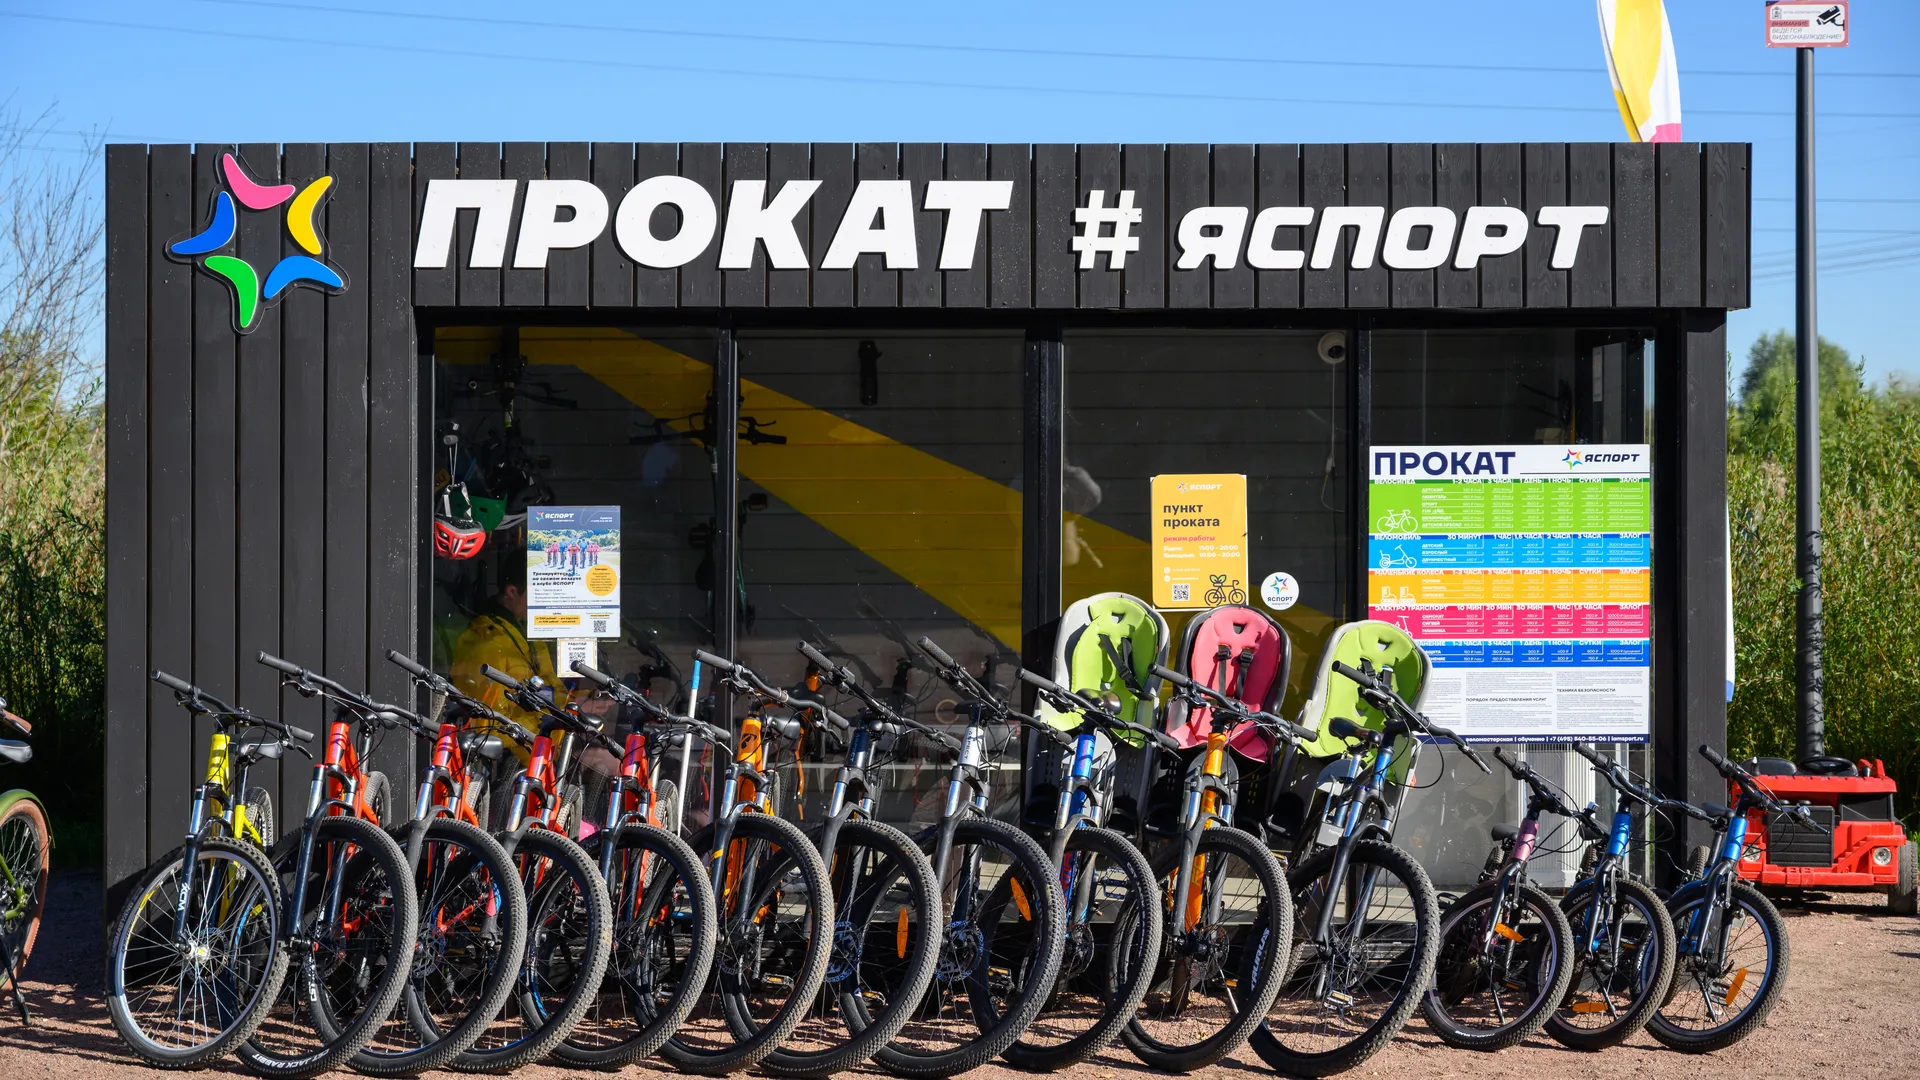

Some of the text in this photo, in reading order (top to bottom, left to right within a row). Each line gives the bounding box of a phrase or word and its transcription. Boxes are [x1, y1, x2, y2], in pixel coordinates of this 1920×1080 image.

[413, 175, 1014, 270] ПРОКАТ
[1176, 206, 1609, 271] ЯСПОРТ
[1375, 452, 1516, 476] ПРОКАТ
[1584, 454, 1640, 462] ЯСПОРТ
[1163, 504, 1203, 515] пункт
[1163, 518, 1220, 529] проката
[178, 886, 189, 911] XCM
[252, 1053, 286, 1068] RABBIT
[285, 1057, 312, 1068] JACK
